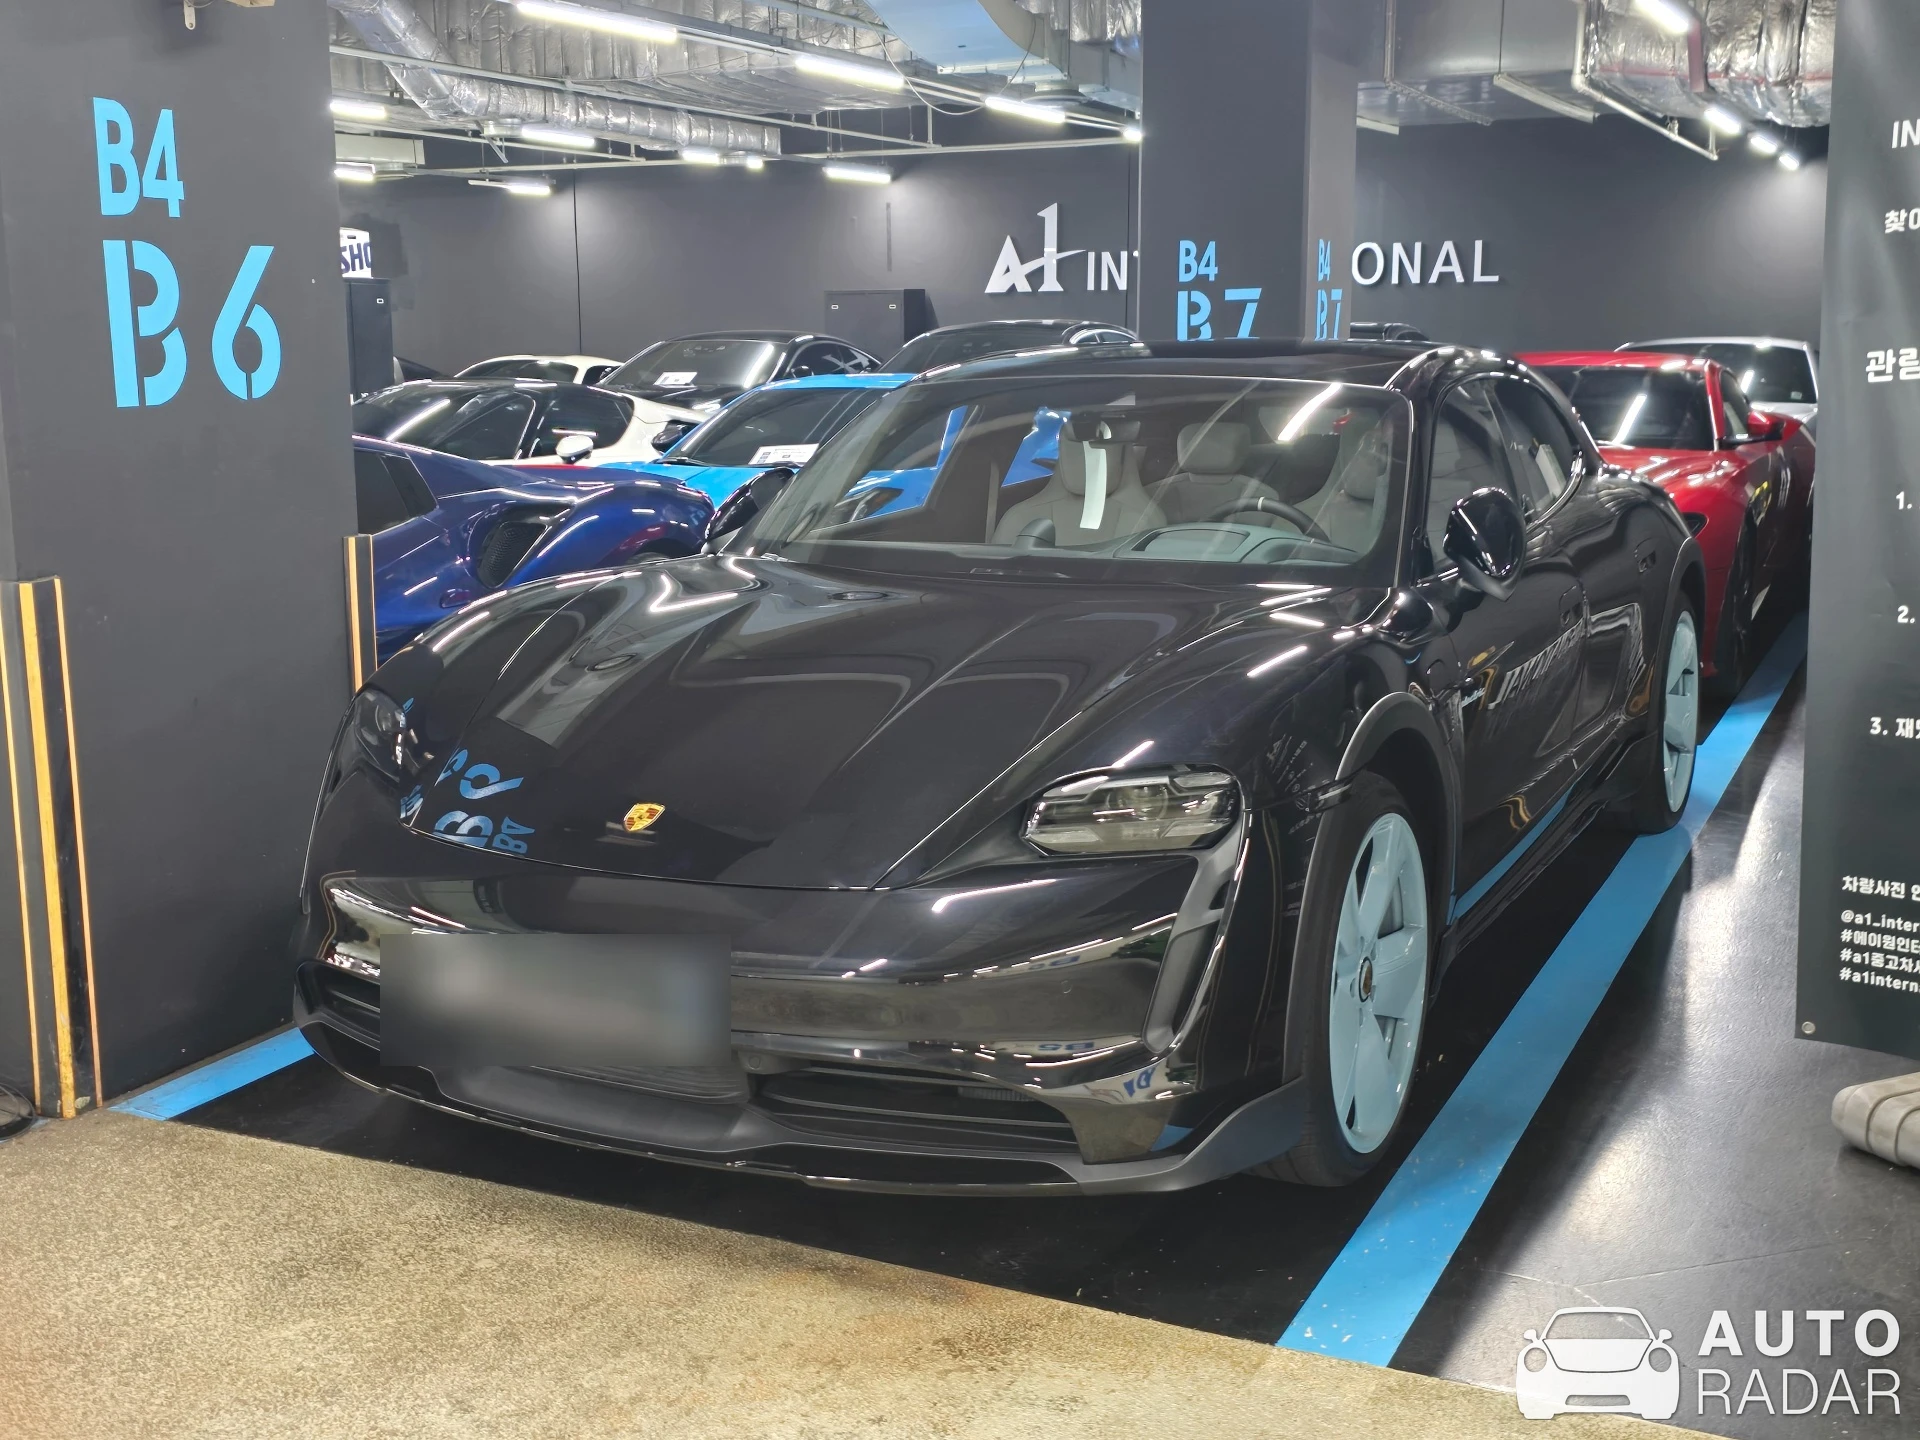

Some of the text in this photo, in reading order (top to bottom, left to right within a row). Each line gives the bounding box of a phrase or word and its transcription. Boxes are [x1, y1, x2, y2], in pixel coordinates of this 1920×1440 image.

[93, 97, 184, 218] B4
[985, 202, 1086, 294] A1
[1087, 250, 1139, 291] IN
[1178, 239, 1218, 283] B4
[1317, 239, 1332, 282] B4
[1895, 490, 1913, 510] 1.
[1897, 604, 1916, 624] 2.
[1869, 716, 1889, 736] 3.
[1842, 875, 1906, 899] 차량사진
[1839, 966, 1920, 993] #a1intern
